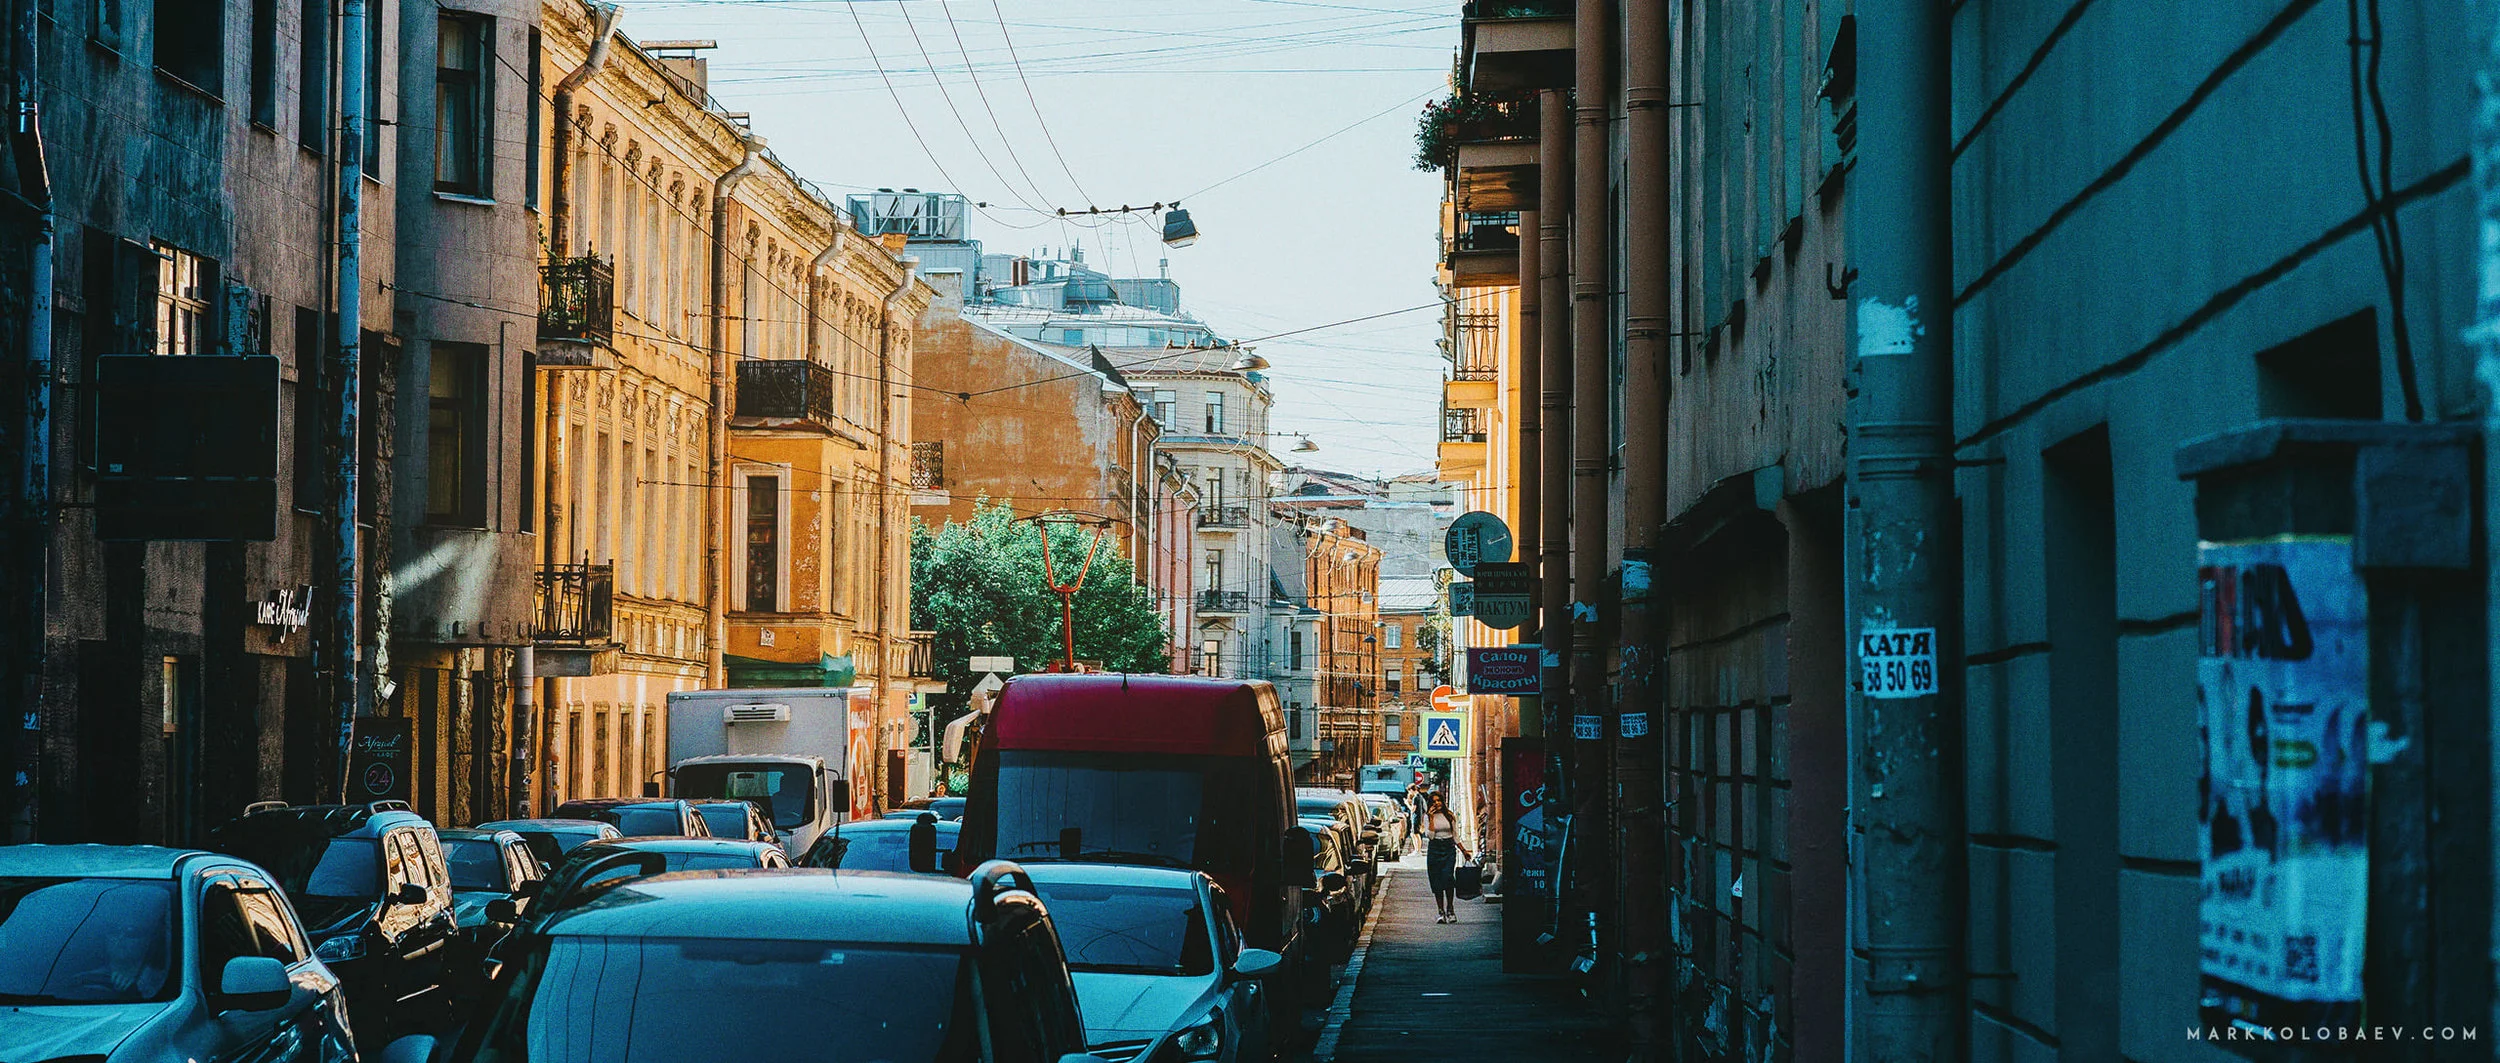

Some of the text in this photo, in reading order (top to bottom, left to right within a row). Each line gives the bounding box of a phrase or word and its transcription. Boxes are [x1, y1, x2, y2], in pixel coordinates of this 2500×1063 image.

[258, 600, 275, 625] КАФЕ
[1476, 601, 1528, 616] ПАКТУМ
[1863, 632, 1931, 656] КАТЯ
[1479, 652, 1527, 663] Салон
[1472, 674, 1537, 690] Красоты
[1886, 661, 1906, 691] 50
[1911, 660, 1932, 690] 69
[369, 769, 390, 787] 24
